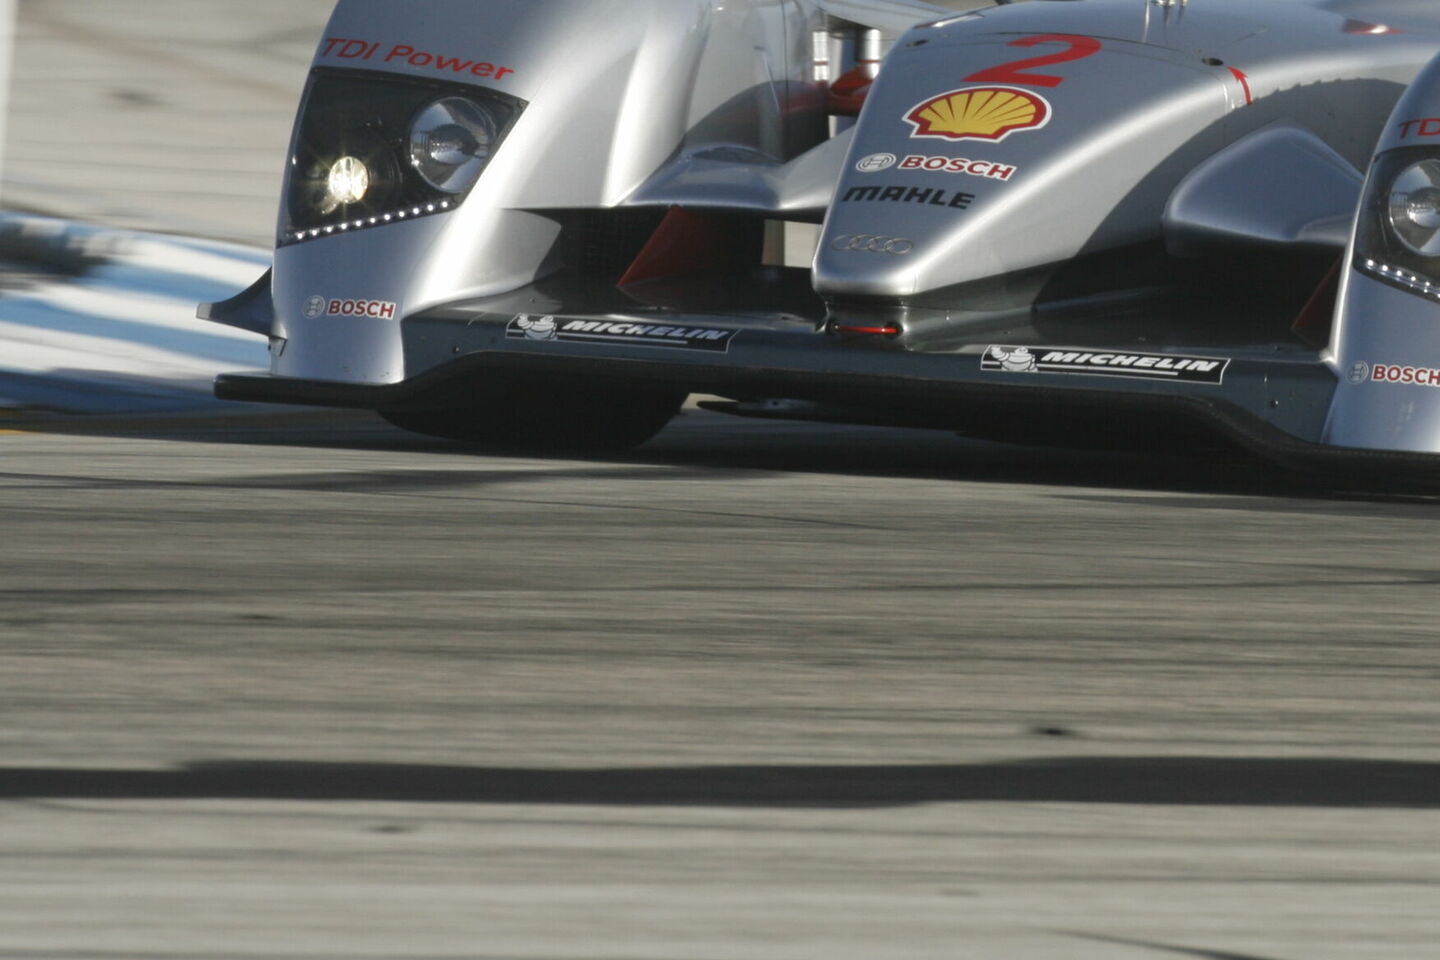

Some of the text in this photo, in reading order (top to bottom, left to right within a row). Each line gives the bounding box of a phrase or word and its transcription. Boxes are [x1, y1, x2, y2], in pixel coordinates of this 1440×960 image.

[322, 37, 515, 81] TDI Power
[959, 33, 1104, 88] 2
[898, 154, 1017, 181] BOSCH
[842, 186, 976, 210] MAHLE
[327, 299, 396, 319] BOSCH
[561, 320, 729, 340] MICHELIN
[1040, 350, 1220, 372] MICHELIN
